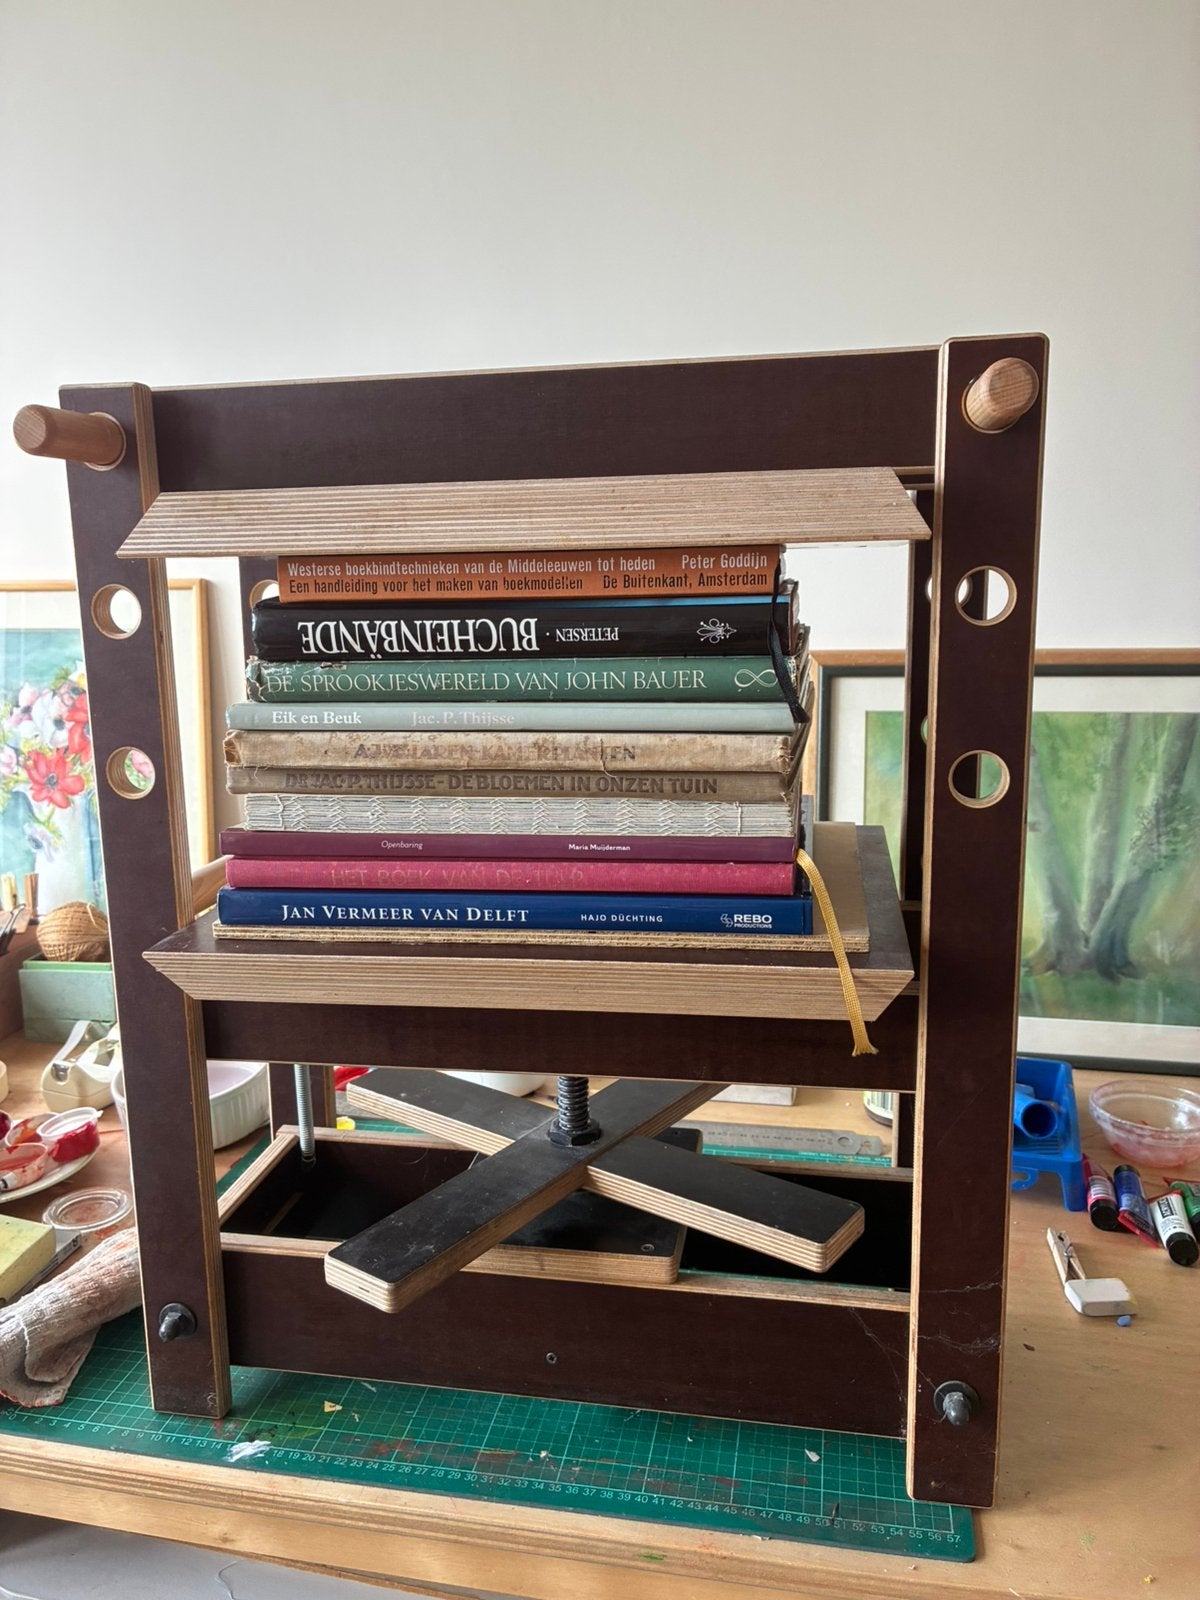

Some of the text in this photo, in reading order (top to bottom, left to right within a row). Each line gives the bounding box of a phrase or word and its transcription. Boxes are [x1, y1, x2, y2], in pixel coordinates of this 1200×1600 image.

[287, 556, 656, 577] Westerse boekbindtechnieken van de Middeleeuwen tot heden
[682, 553, 768, 570] Peter Goddijn
[289, 575, 583, 595] Een handleiding voor het maken van boekmodellen
[603, 571, 768, 589] De Buitenkant, Amsterdam
[297, 617, 620, 660] BUCHEINBÄNDE PETERSEN
[267, 670, 708, 694] DE SPROOKJESWERELD VAN JOHN BAUER
[272, 711, 362, 725] Eik en Beuk
[410, 711, 515, 728] Jac. P. Thijsse
[450, 775, 473, 790] DE
[477, 774, 564, 792] BLOEMEN
[570, 775, 591, 792] IN
[598, 776, 665, 793] ONZEN
[667, 777, 718, 794] TUIN
[381, 840, 423, 850] Openbaring
[568, 843, 589, 851] Maria
[331, 868, 368, 886] HET
[282, 904, 529, 922] JAN VERMEER VAN DELFT
[580, 912, 663, 924] HAJO DÜCHTING
[734, 913, 772, 924] REBO
[151, 1434, 163, 1442] 10
[181, 1438, 193, 1446] 12
[196, 1440, 208, 1448] 13
[273, 1450, 285, 1458] 18
[288, 1451, 301, 1460] 19
[302, 1453, 316, 1462] 20
[318, 1455, 332, 1464] 21
[335, 1456, 349, 1466] 22
[350, 1459, 364, 1468] 23
[366, 1462, 380, 1470] 24
[383, 1463, 397, 1472] 25
[398, 1466, 413, 1474] 26
[415, 1467, 429, 1476] 27
[431, 1469, 445, 1478] 28
[448, 1472, 462, 1480] 29
[464, 1474, 478, 1482] 30
[497, 1478, 512, 1487] 32
[515, 1480, 529, 1489] 33
[549, 1484, 562, 1493] 35
[566, 1486, 580, 1495] 36
[583, 1488, 597, 1497] 37
[600, 1491, 614, 1499] 38
[618, 1493, 632, 1502] 39
[635, 1495, 649, 1504] 40
[652, 1498, 665, 1506] 41
[670, 1500, 684, 1509] 42
[688, 1502, 702, 1511] 43
[705, 1504, 719, 1513] 44
[723, 1506, 738, 1515] 45
[742, 1509, 756, 1517] 46
[760, 1511, 774, 1519] 47
[778, 1513, 793, 1522] 48
[797, 1516, 811, 1525] 49
[852, 1523, 867, 1532] 52
[870, 1525, 886, 1535] 53
[890, 1528, 904, 1537] 54
[909, 1530, 924, 1539] 55
[928, 1532, 942, 1542] 56
[947, 1534, 961, 1543] 57
